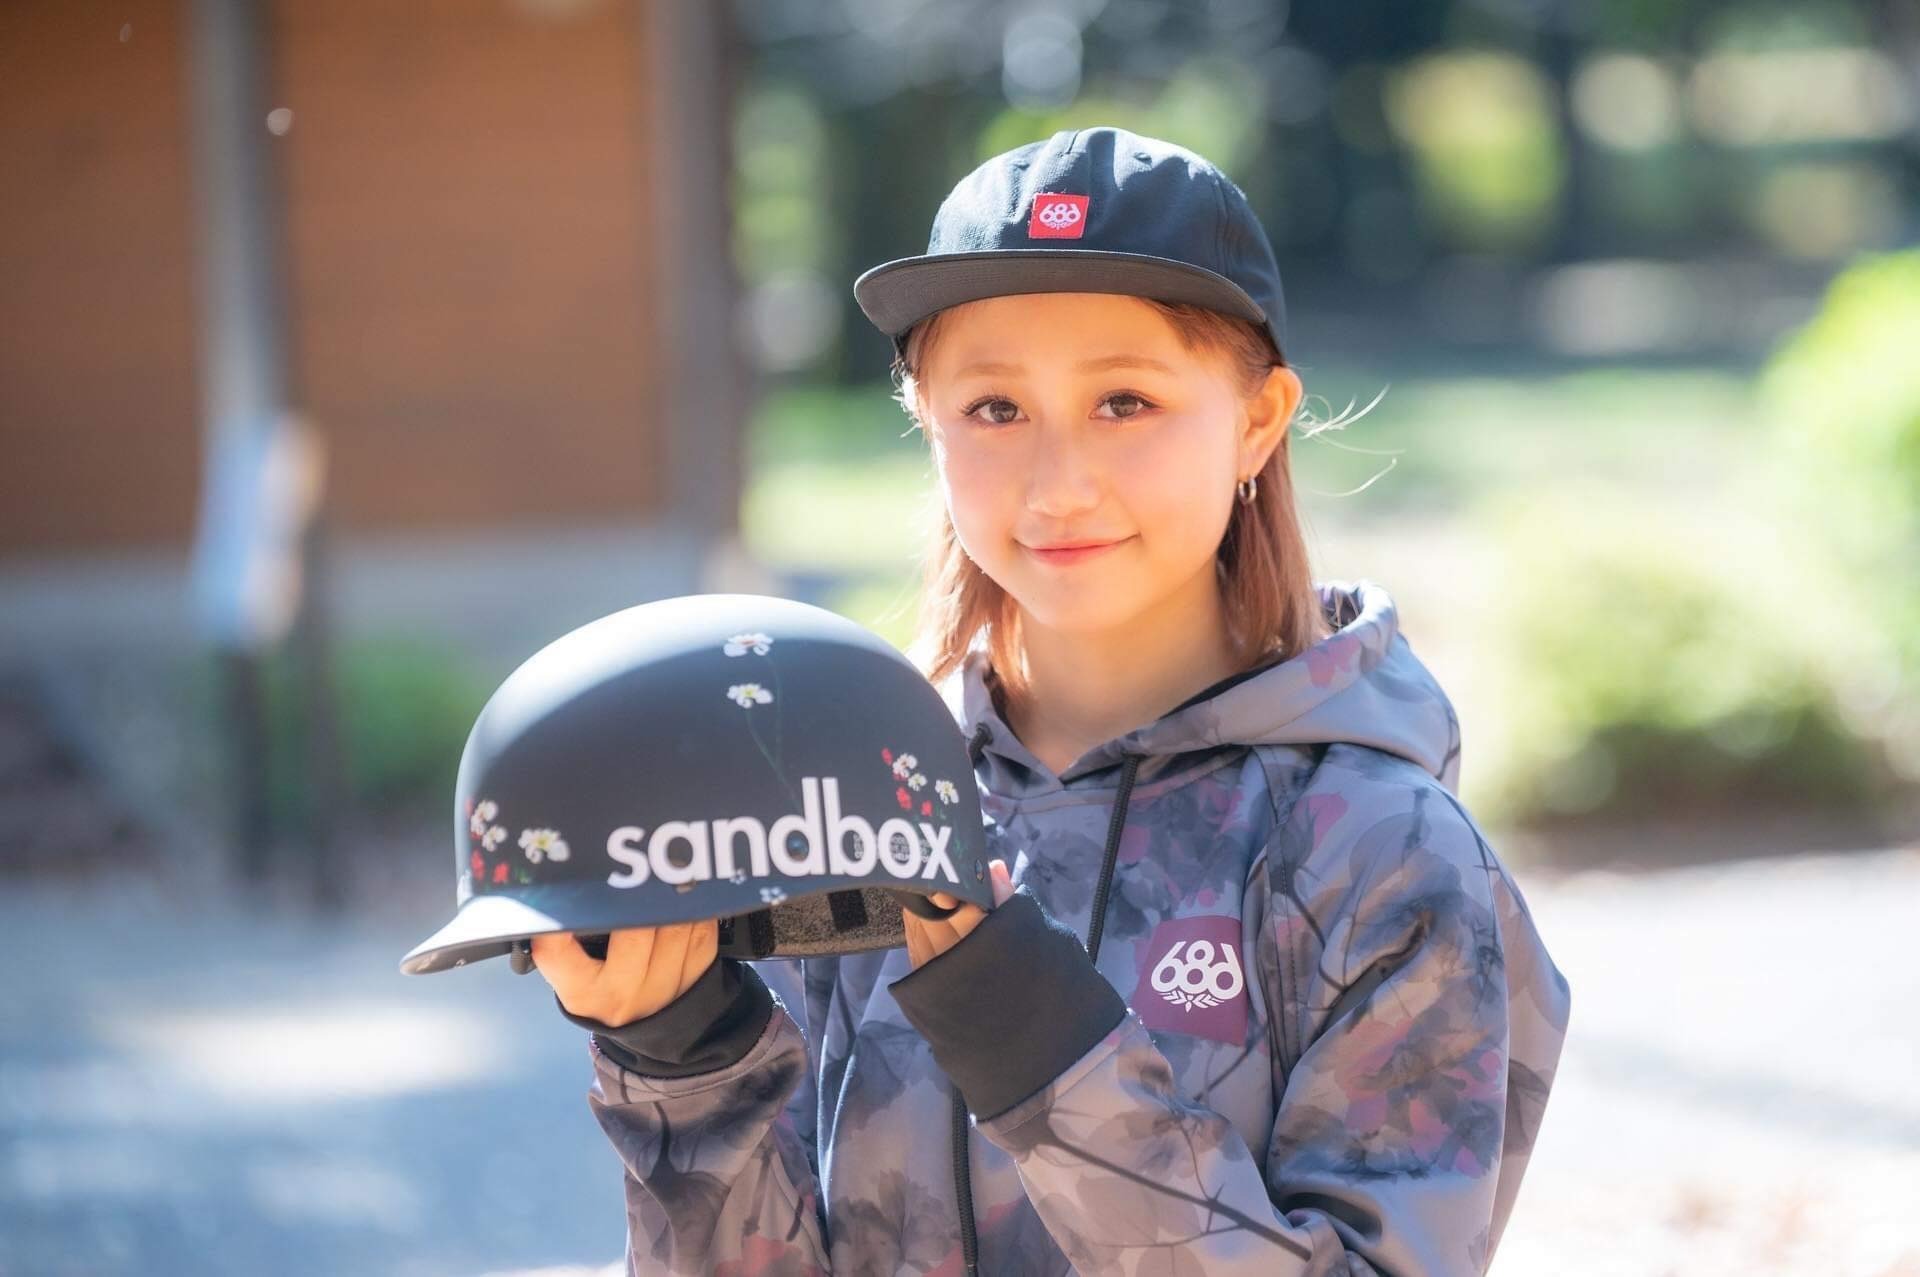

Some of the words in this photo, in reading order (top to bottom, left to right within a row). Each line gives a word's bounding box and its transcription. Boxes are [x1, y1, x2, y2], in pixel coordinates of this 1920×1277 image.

[1039, 203, 1082, 224] 686
[606, 777, 960, 889] sandbox
[1151, 940, 1243, 1000] 686
